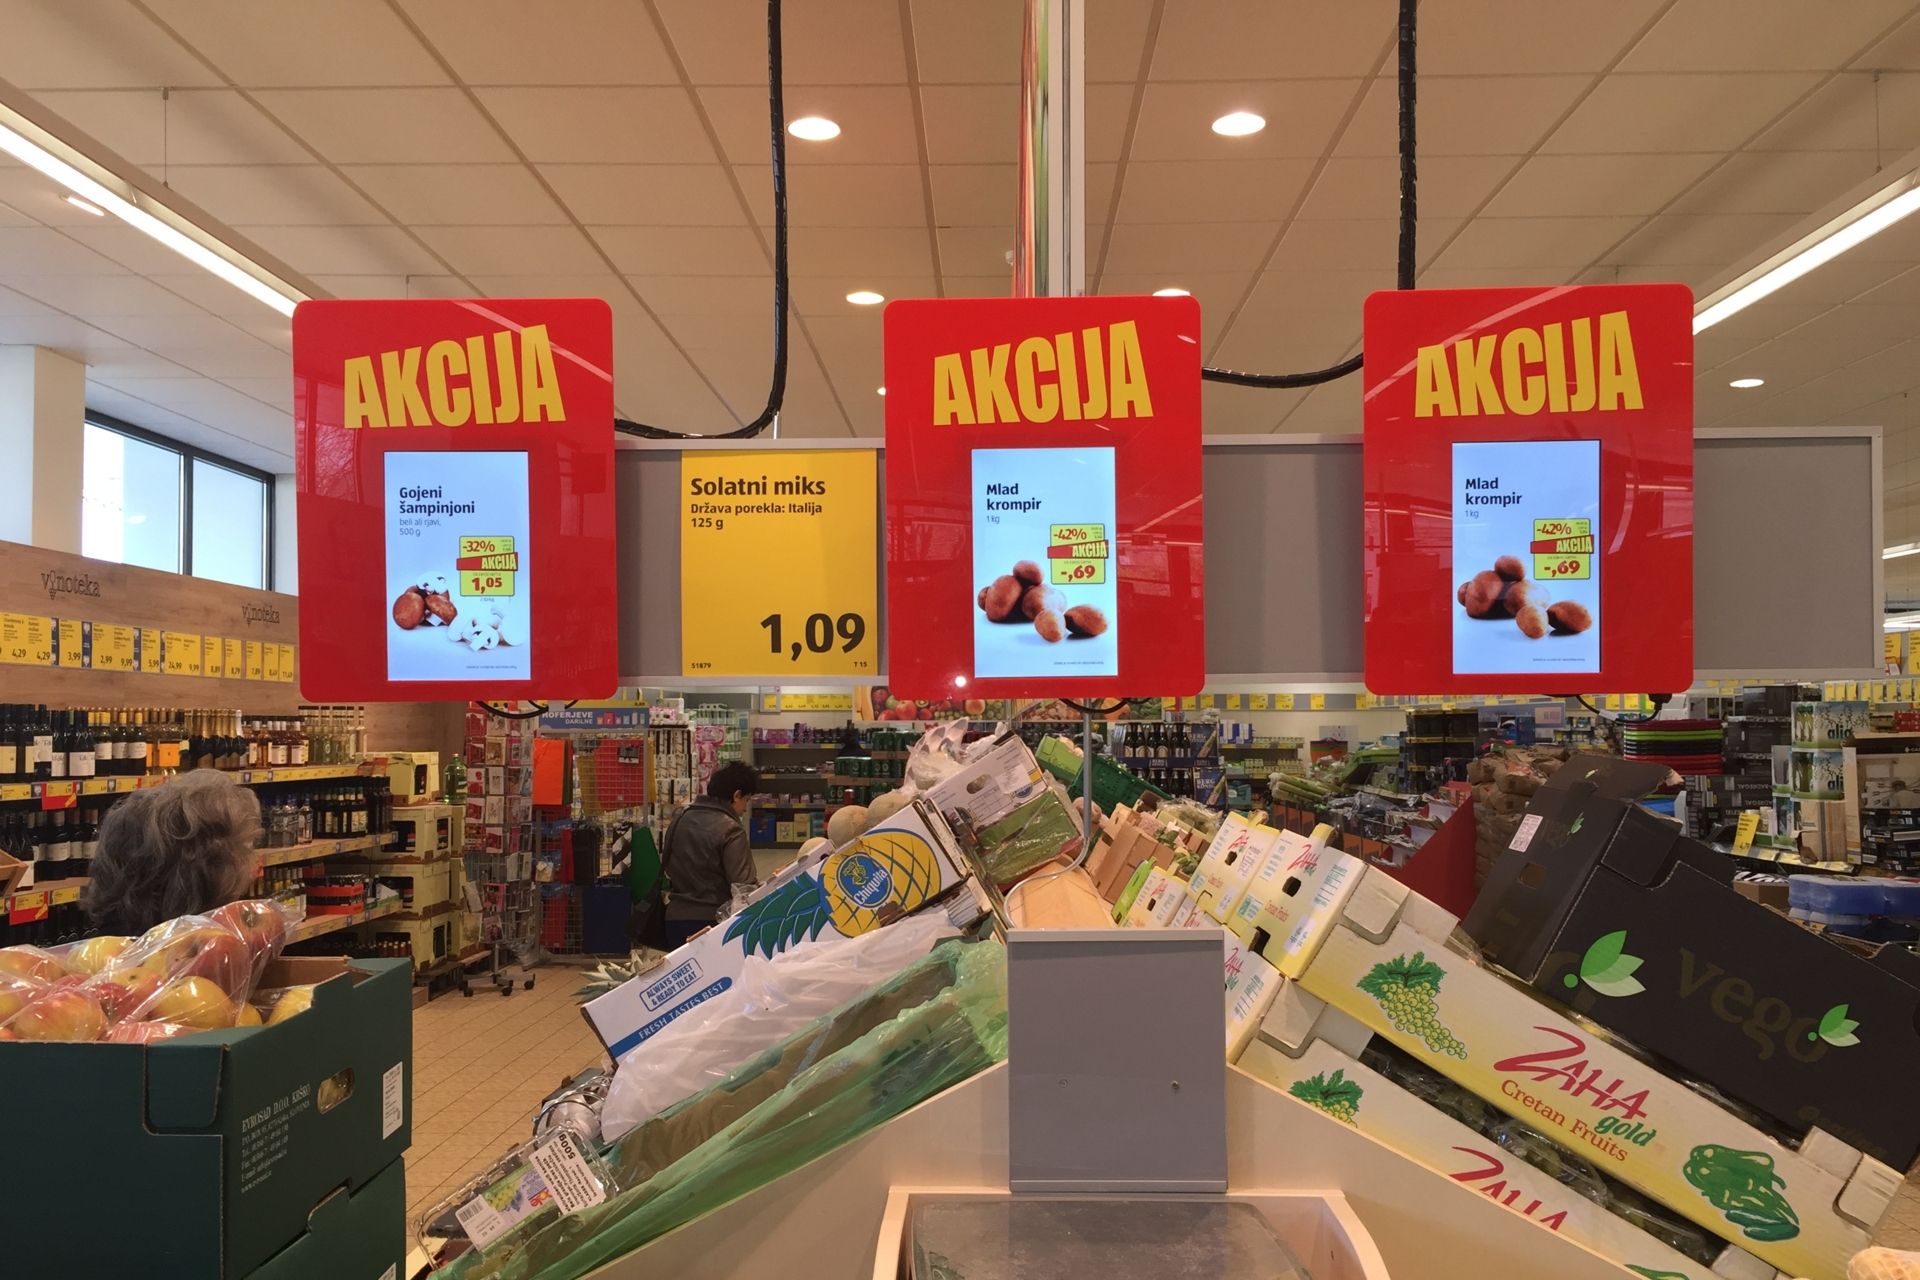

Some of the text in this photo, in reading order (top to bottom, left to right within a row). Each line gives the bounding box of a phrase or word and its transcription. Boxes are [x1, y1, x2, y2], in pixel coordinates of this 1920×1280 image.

[1415, 310, 1644, 418] AKCIJA
[344, 324, 566, 428] AKCIJA
[934, 320, 1153, 426] AKCIJA
[691, 475, 826, 496] Solatni miks
[986, 483, 1019, 495] Mlad
[1466, 478, 1499, 490] Mlad
[400, 486, 442, 501] Gojeni
[1466, 492, 1522, 507] krompir
[400, 501, 475, 516] šampinjoni
[691, 502, 822, 516] Država porekla: Italija
[987, 498, 1041, 512] krompir
[400, 518, 413, 526] beli
[414, 518, 423, 526] ali
[691, 518, 723, 530] 125 g
[1537, 523, 1572, 535] -42%
[400, 528, 421, 537] 500 g
[1053, 529, 1087, 540] -42%
[463, 541, 496, 552] -32%
[1072, 541, 1107, 558] AKCIJA
[1556, 535, 1593, 553] AKCIJA
[481, 553, 516, 570] AKCIJA
[1544, 560, 1580, 577] -,69
[1060, 565, 1096, 582] -,69
[472, 577, 502, 594] 1,05
[761, 613, 866, 662] 1,09
[854, 868, 888, 905] Chiquita
[646, 963, 693, 999] ALWAYS SWEET
[657, 985, 678, 1004] READY
[677, 980, 686, 989] TO
[685, 971, 697, 985] EAT
[639, 982, 724, 1039] FRESH TASTES BEST
[1493, 1026, 1650, 1119] ZAHA
[1501, 1079, 1628, 1162] Cretan Fruits
[1594, 1115, 1657, 1146] gold
[559, 1133, 576, 1160] 500g
